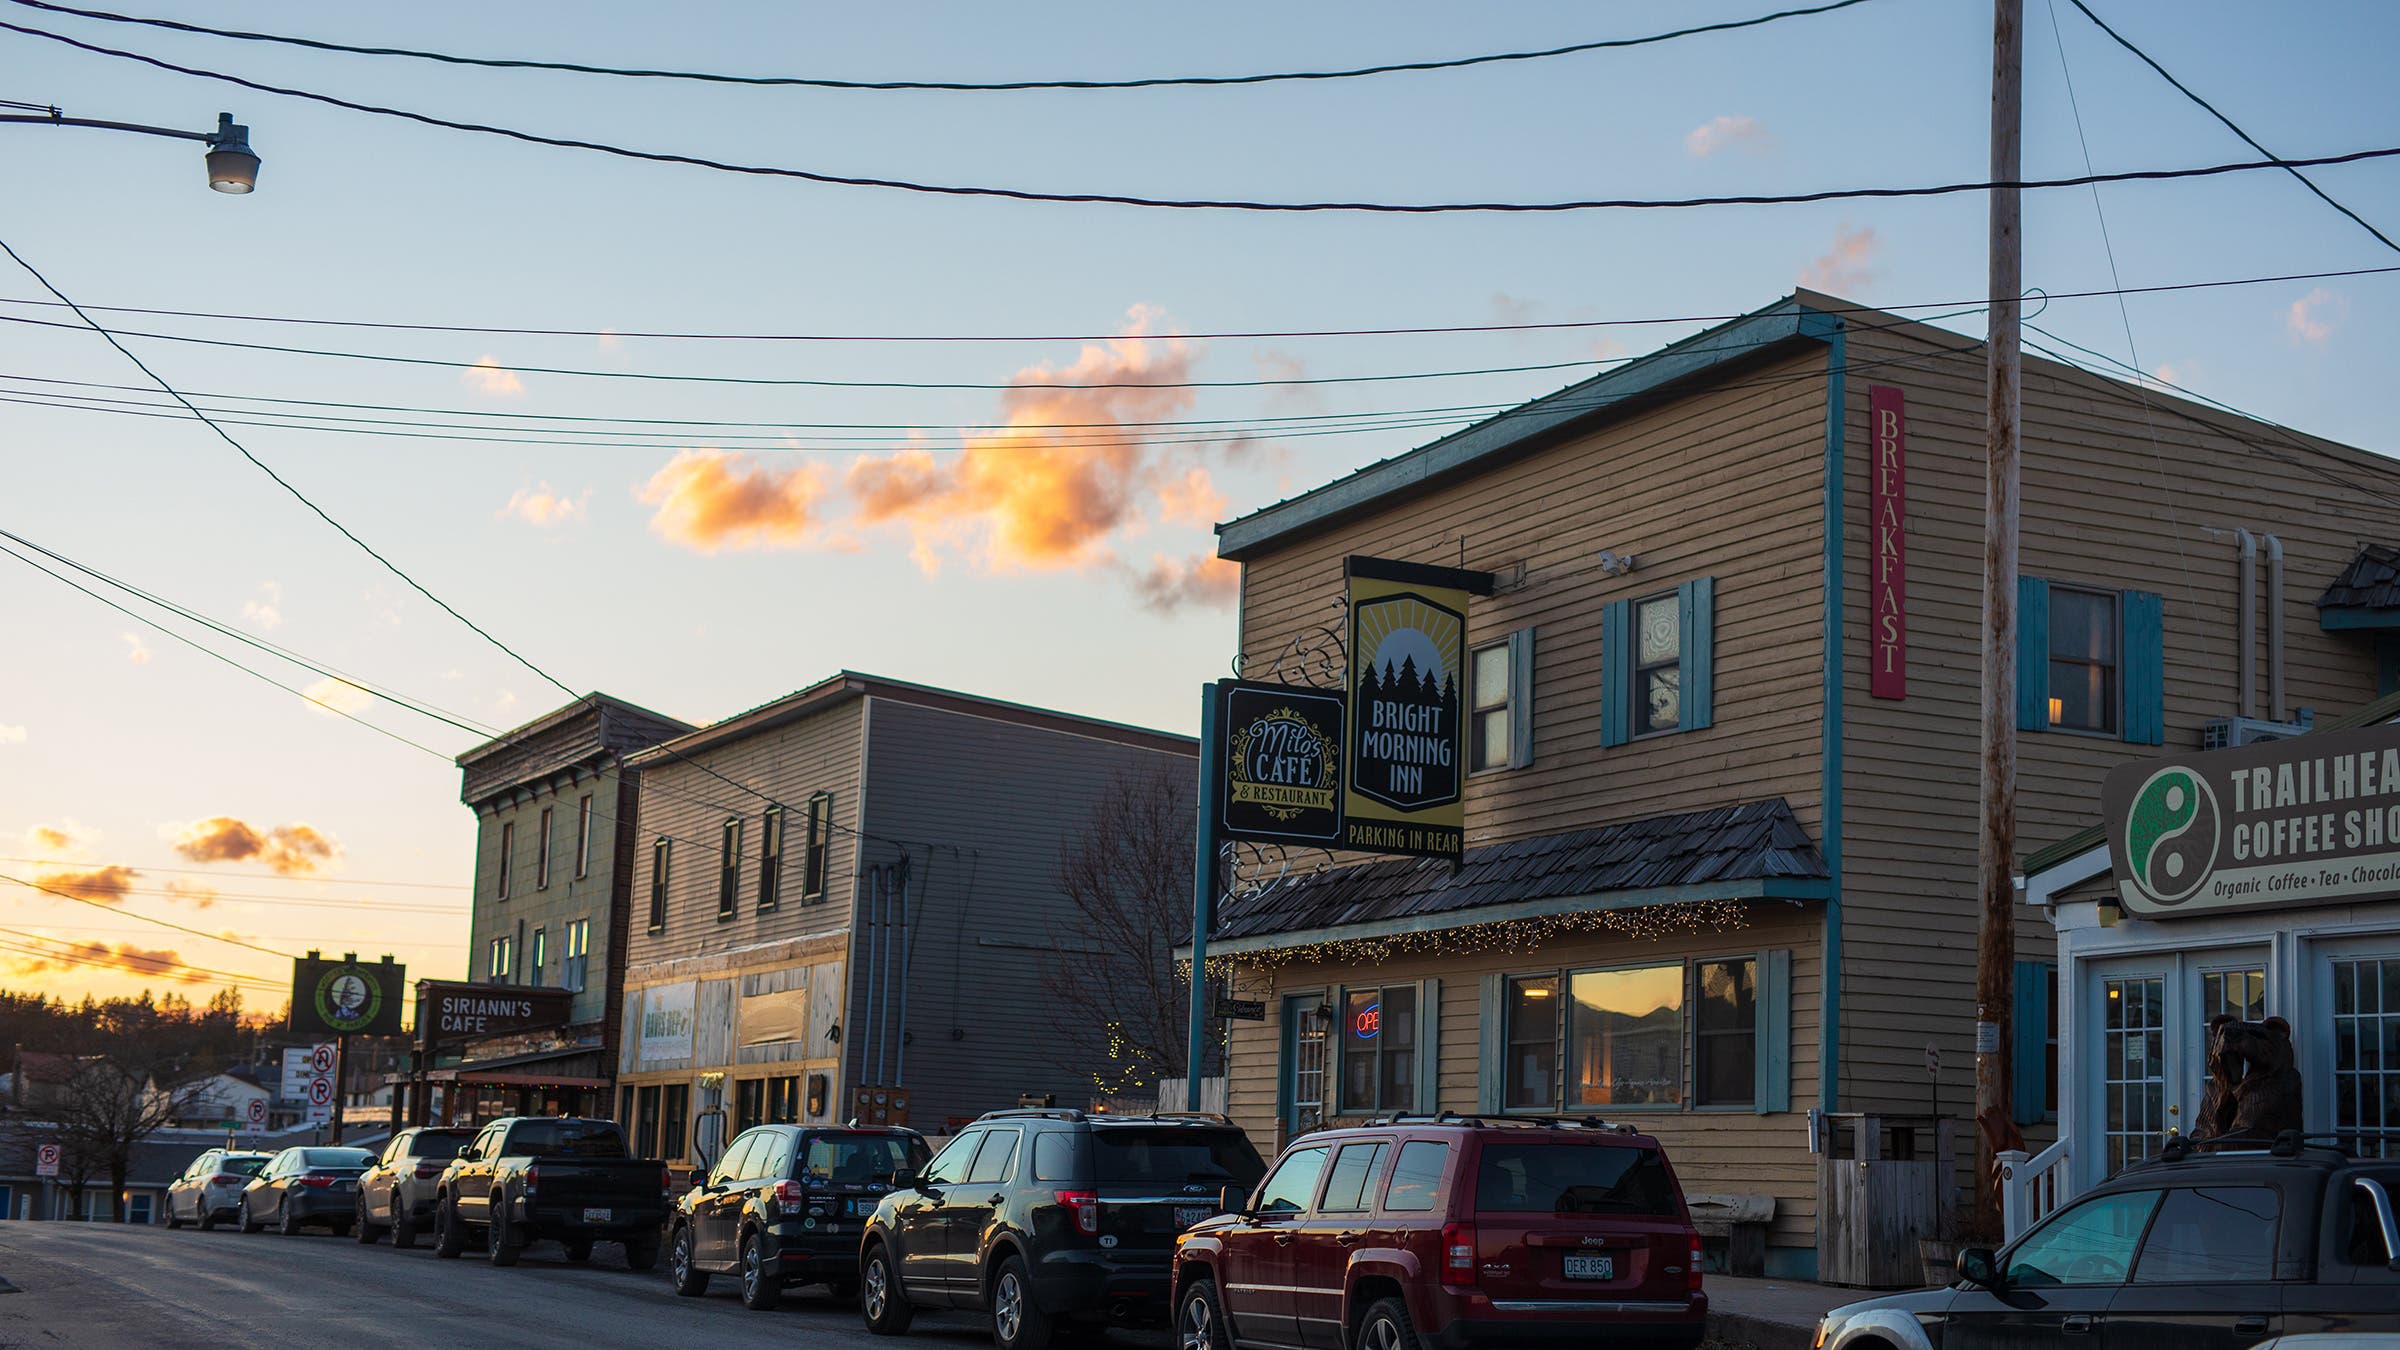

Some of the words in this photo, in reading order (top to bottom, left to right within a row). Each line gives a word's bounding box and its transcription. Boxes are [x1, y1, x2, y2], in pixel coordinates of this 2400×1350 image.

[1879, 408, 1898, 674] BREAKFAST
[1372, 700, 1443, 734] BRIGHT
[1249, 719, 1322, 758] Milo's
[1362, 730, 1451, 766] MORNING
[1256, 753, 1313, 785] CAFÉ
[1390, 764, 1423, 795] INN
[2231, 748, 2400, 813] TRAILHEA
[1240, 784, 1250, 799] &
[1253, 786, 1327, 806] RESTAURANT
[1349, 824, 1404, 849] PARKING
[1409, 830, 1423, 851] IN
[1427, 832, 1459, 853] REAR
[2232, 813, 2336, 861] COFFEE
[2344, 805, 2400, 849] SHO
[2214, 876, 2261, 899] Organic
[2267, 873, 2308, 891] Coffee
[2319, 870, 2340, 887] Tea
[2351, 862, 2400, 883] Chocola
[442, 997, 532, 1018] SIRIANNI'S
[1357, 1011, 1379, 1031] OPE
[441, 1015, 488, 1033] CAFE
[1581, 1235, 1604, 1247] Jeep
[1566, 1259, 1586, 1273] DER
[1590, 1259, 1611, 1273] 850
